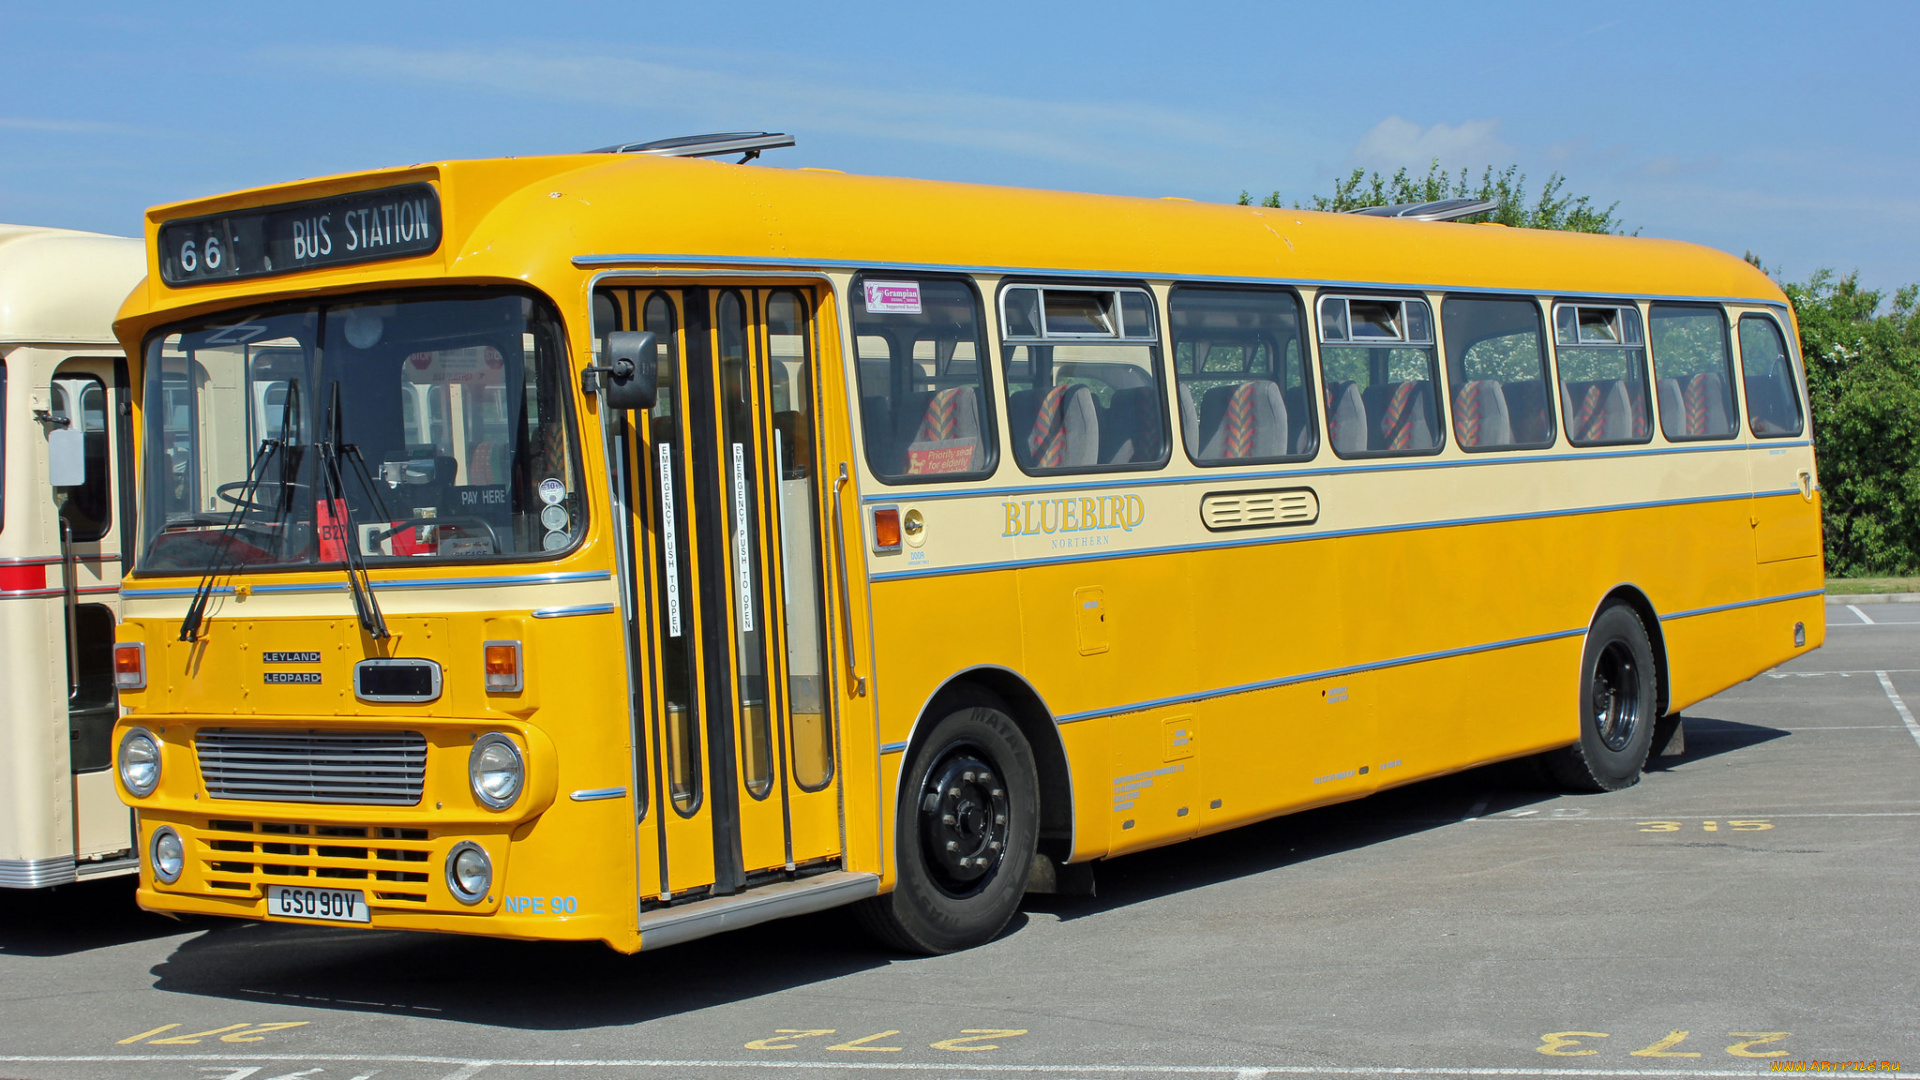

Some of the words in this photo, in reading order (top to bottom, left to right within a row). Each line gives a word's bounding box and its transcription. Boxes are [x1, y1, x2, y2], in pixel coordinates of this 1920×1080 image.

[292, 215, 333, 260] BUS
[344, 198, 430, 252] STATION
[180, 236, 222, 272] 66
[884, 288, 918, 299] Grampian
[927, 450, 955, 460] Priority
[956, 446, 973, 456] seat
[928, 460, 940, 470] for
[941, 457, 969, 468] elderly
[661, 445, 673, 528] EMERGENCY
[734, 445, 745, 525] EMERGENCY
[461, 490, 478, 505] PAY
[482, 489, 506, 504] HERE
[1001, 494, 1145, 538] BLUEBIRD
[667, 532, 675, 568] PUSH
[1051, 534, 1110, 549] NORTHERN
[669, 575, 676, 593] TO
[742, 571, 749, 589] TO
[670, 599, 679, 634] OPEN
[743, 594, 751, 628] OPEN
[265, 652, 319, 661] LEYLAND
[266, 673, 320, 682] LEOPARD
[1635, 819, 1776, 832] 315
[505, 895, 546, 914] NPE
[550, 895, 578, 914] 90
